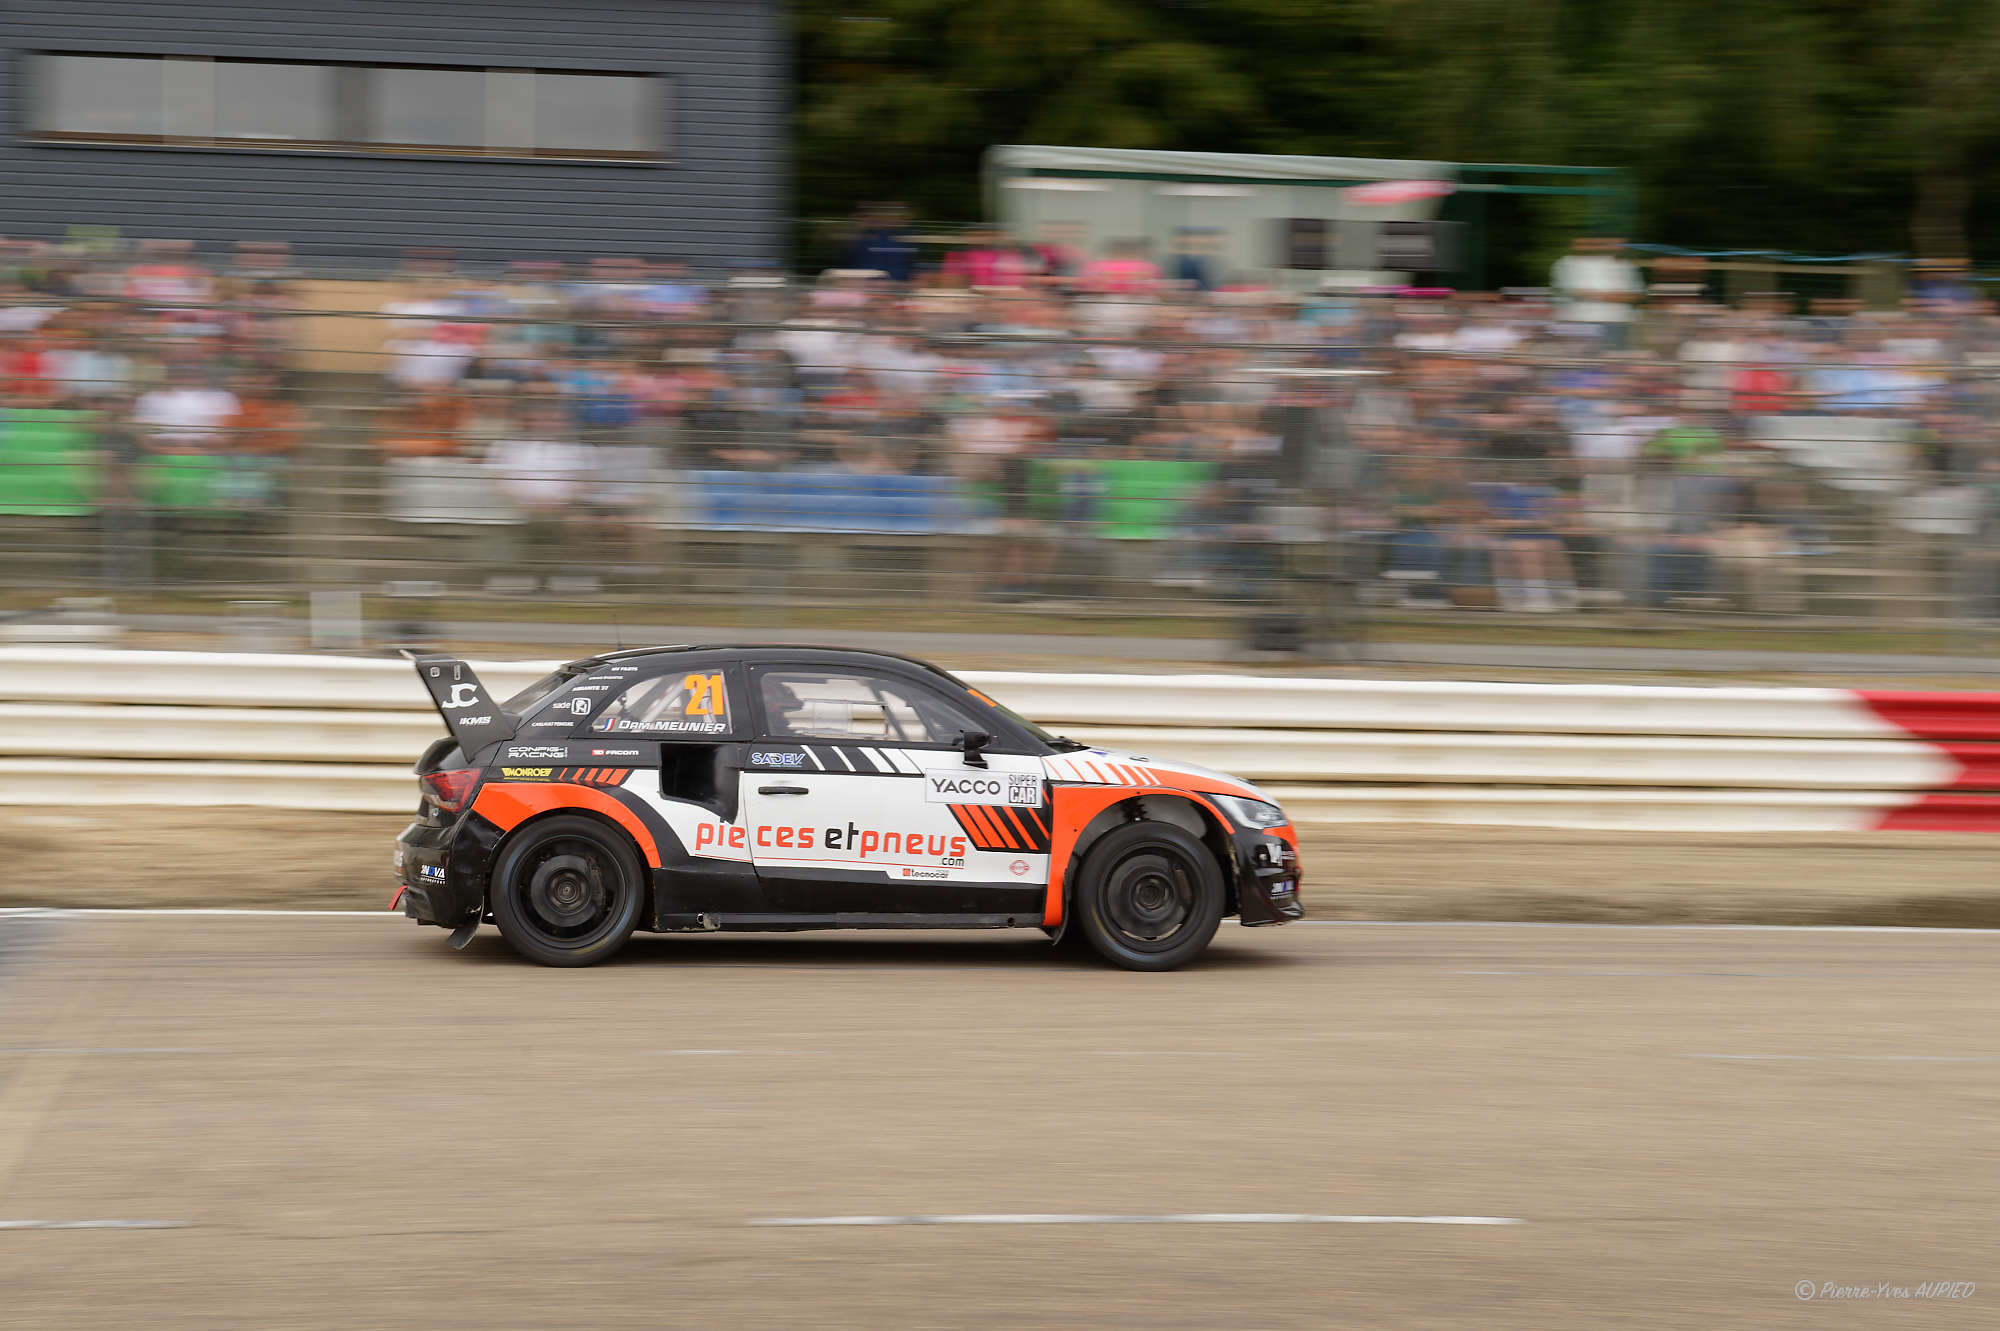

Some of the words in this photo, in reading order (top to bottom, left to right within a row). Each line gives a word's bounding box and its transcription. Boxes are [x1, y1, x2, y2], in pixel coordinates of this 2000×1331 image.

[684, 674, 724, 715] 21
[655, 721, 726, 733] MEUNIER
[751, 752, 806, 766] SADEV
[508, 768, 546, 777] MONROE
[931, 778, 1001, 795] YACCO
[1008, 774, 1037, 786] SUPER
[1009, 786, 1036, 804] CAR
